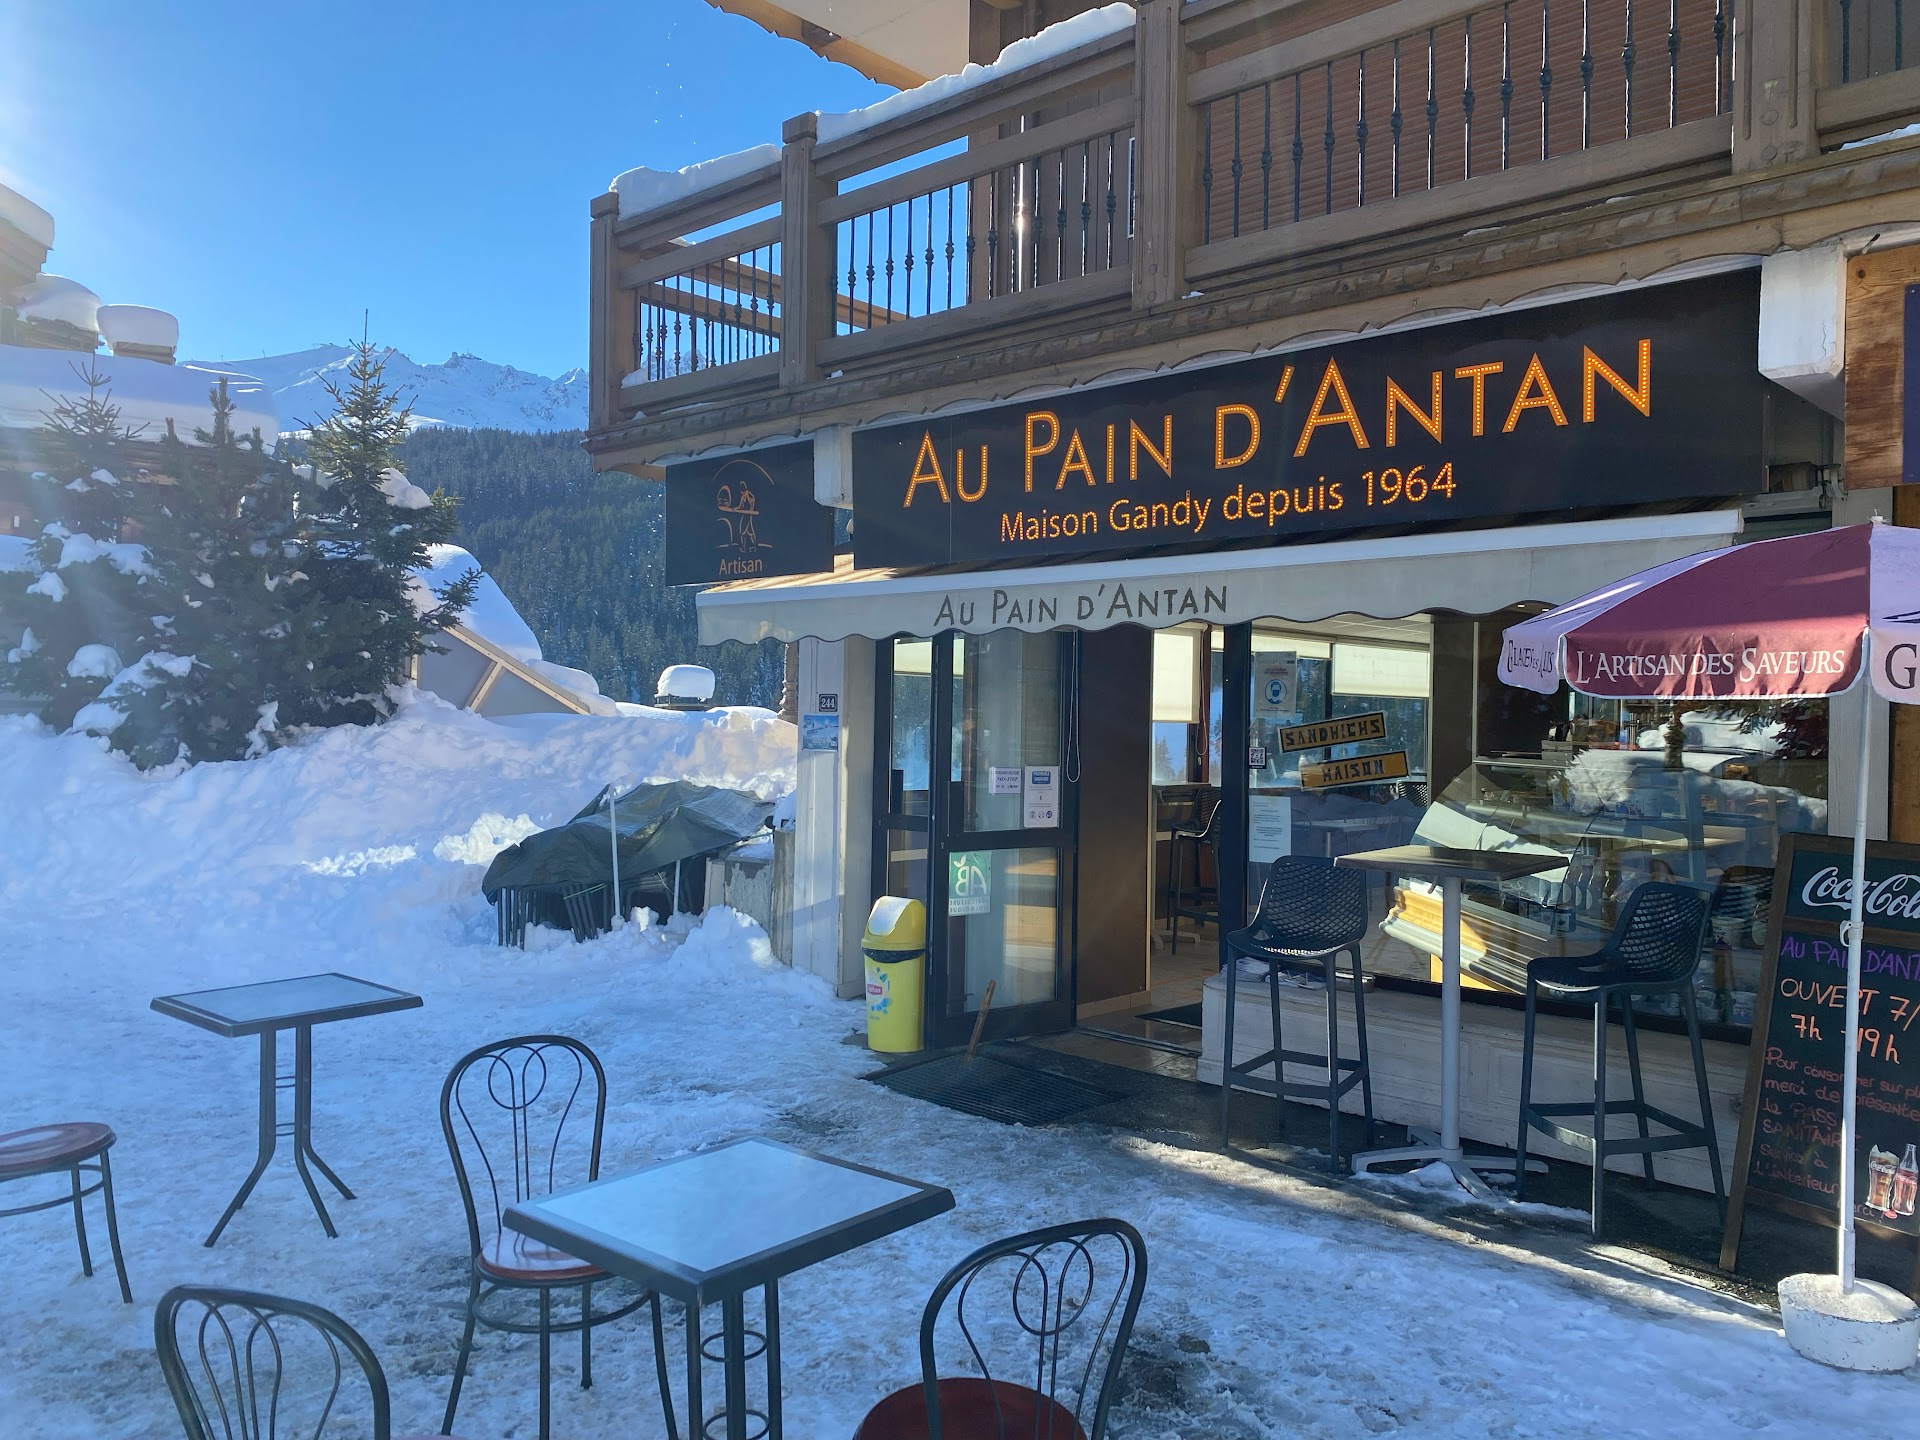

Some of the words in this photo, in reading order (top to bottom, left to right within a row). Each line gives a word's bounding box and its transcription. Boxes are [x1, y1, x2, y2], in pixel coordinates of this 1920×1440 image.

[903, 429, 988, 507] AU
[1024, 411, 1172, 492] PAIN
[1214, 338, 1651, 470] D'ANTAN
[1001, 509, 1098, 543] Maison
[1108, 489, 1212, 534] Gandy
[1222, 475, 1344, 527] depuis
[1362, 461, 1457, 507] 1964
[719, 557, 763, 576] Artisan
[933, 594, 974, 627] AU
[992, 589, 1057, 624] PAIN
[1077, 582, 1228, 620] D'ANTAN
[1575, 649, 1689, 684] L'ARTISAN
[1691, 653, 1734, 676] DES
[1739, 648, 1846, 684] SAVEURS
[821, 697, 836, 708] 244
[1322, 759, 1385, 783] MAISON
[1781, 937, 1806, 958] AU
[1812, 941, 1848, 968] PAI
[1863, 949, 1920, 981] D'ANT
[1790, 1013, 1823, 1041] 7h
[1765, 1046, 1799, 1070] Pour
[1880, 1080, 1904, 1094] sur
[1765, 1079, 1808, 1096] merci
[1815, 1086, 1841, 1103] de
[1762, 1098, 1782, 1115] le
[1791, 1102, 1838, 1127] PASS
[1814, 1150, 1829, 1169] à
